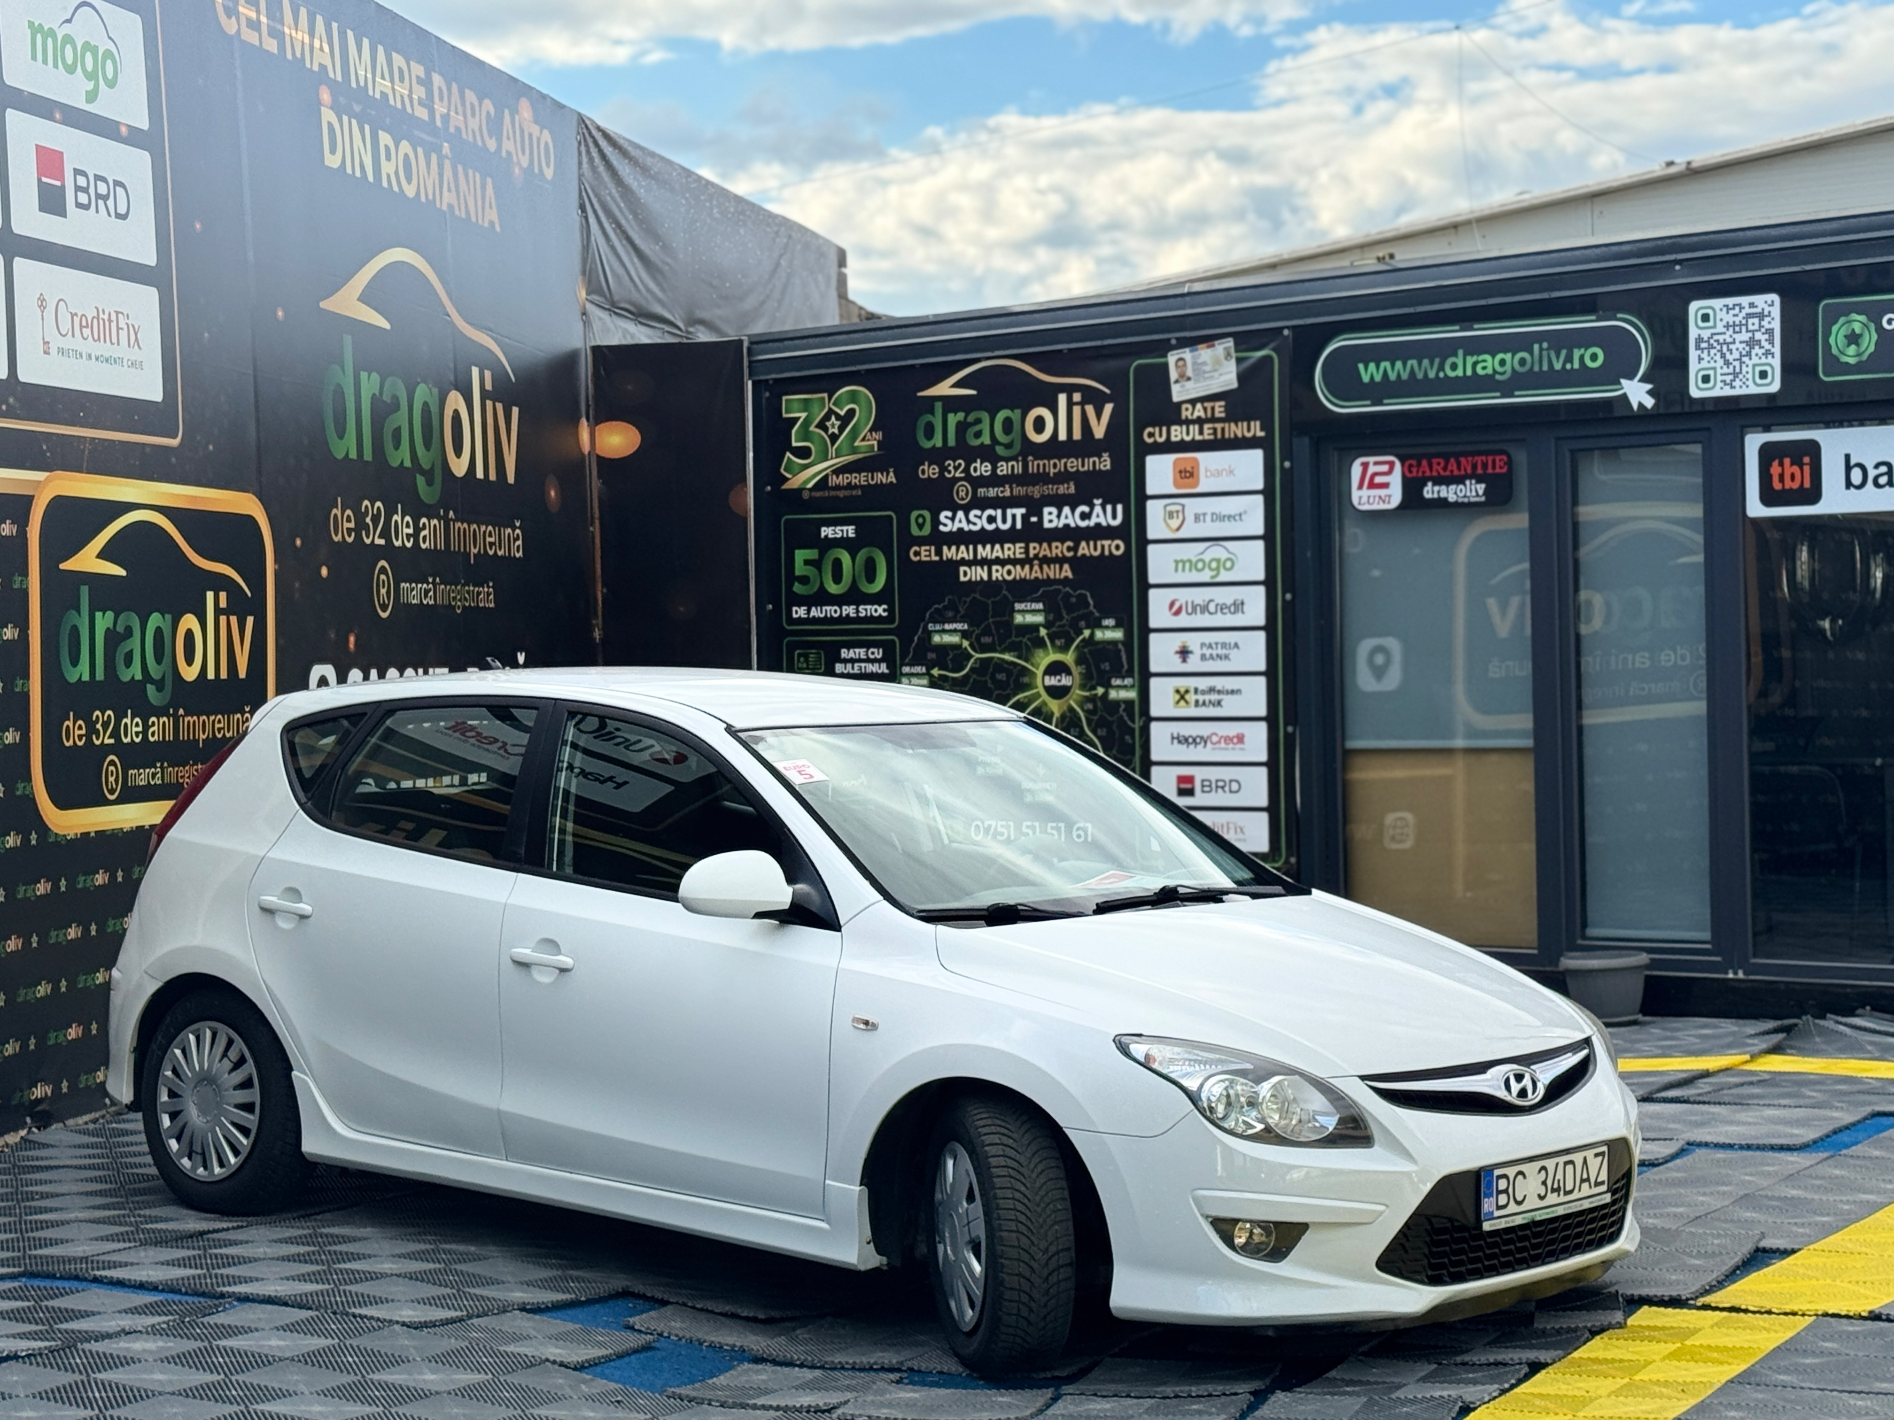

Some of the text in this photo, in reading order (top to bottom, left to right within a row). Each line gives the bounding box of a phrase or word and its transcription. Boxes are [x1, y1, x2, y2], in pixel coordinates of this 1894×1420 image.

[27, 19, 119, 105] mogo
[214, 0, 555, 181] CEL MAI MARE PARC AUTO
[320, 104, 501, 233] DIN ROMÂNIA
[72, 167, 131, 221] BRD
[54, 297, 142, 351] CreditFix
[57, 346, 144, 371] PRIETEN IN MOMENTE CHEIE
[1358, 342, 1605, 384] www.dragoliv.ro
[322, 334, 519, 505] dragoliv
[1181, 401, 1226, 420] RATE
[780, 385, 883, 478] 32 ANI
[916, 392, 1115, 457] dragoliv
[1143, 420, 1265, 444] CU BULETINUL
[918, 452, 1111, 479] de 32 de ani împreună
[1178, 465, 1236, 480] tbi bank
[1356, 455, 1508, 491] 12 GARANTIE
[1769, 456, 1811, 490] tbi
[828, 468, 897, 487] ÎMPREUNĂ
[977, 483, 1011, 498] marcă
[1012, 481, 1075, 499] înregistrată
[1357, 479, 1486, 506] LUNI dragoliv
[938, 508, 1026, 532] SASCUT
[1043, 498, 1123, 529] BACĂU
[1168, 510, 1180, 520] BT
[1194, 513, 1207, 524] BT
[329, 497, 523, 564] de 32 de ani împreună
[820, 525, 856, 538] PESTE
[909, 539, 1125, 562] CEL MAI MARE PARC AUTO
[792, 547, 887, 595] 500
[959, 560, 1073, 582] DIN ROMÂNIA
[1173, 557, 1236, 580] mogo
[400, 576, 435, 605] marcă
[436, 576, 495, 614] înregistrată
[1014, 602, 1044, 611] SUCEAVA
[792, 604, 888, 618] DE AUTO PE STOC
[1185, 599, 1245, 616] UniCredit
[928, 622, 968, 631] CLUJ-NAPOCA
[59, 585, 254, 706] dragoliv
[841, 648, 882, 659] RATE CU
[1200, 641, 1240, 651] PATRIA
[835, 663, 889, 674] BULETINUL
[1200, 653, 1231, 662] BANK
[901, 666, 926, 674] ORADEA
[1044, 673, 1073, 686] BACĂU
[1193, 686, 1242, 696] Raiffeisen
[1193, 699, 1224, 708] BANK
[62, 705, 252, 748] de 32 de ani împreună
[1170, 731, 1246, 750] HappyCredit
[128, 762, 162, 787] marcă
[1201, 779, 1242, 794] BRD
[971, 820, 1015, 841] 0751
[1072, 823, 1092, 842] 61
[15, 878, 52, 901] dragoliv
[76, 868, 110, 891] dragoliv
[48, 923, 82, 945] dragoliv
[1495, 1150, 1606, 1211] BC 34DAZ
[1484, 1198, 1494, 1211] RO
